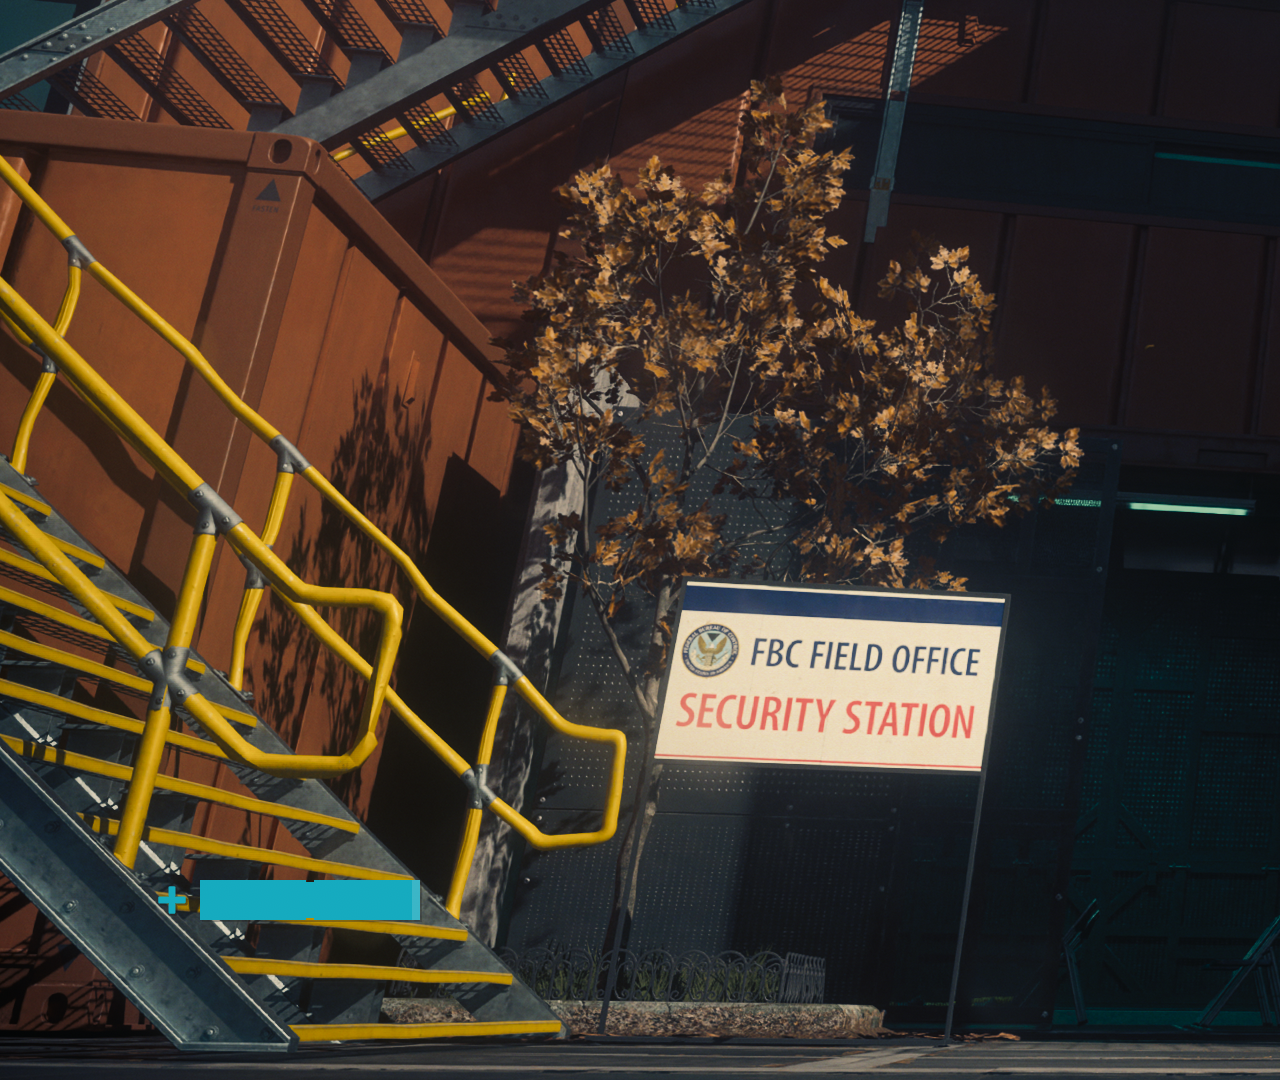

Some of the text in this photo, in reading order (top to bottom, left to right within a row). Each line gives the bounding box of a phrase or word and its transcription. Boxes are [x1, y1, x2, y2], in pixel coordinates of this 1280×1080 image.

[252, 204, 280, 213] FASTEN
[750, 637, 803, 668] FBC
[809, 640, 883, 671] FIELD
[892, 645, 981, 676] OFFICE
[676, 692, 975, 739] SECURITY STATION
